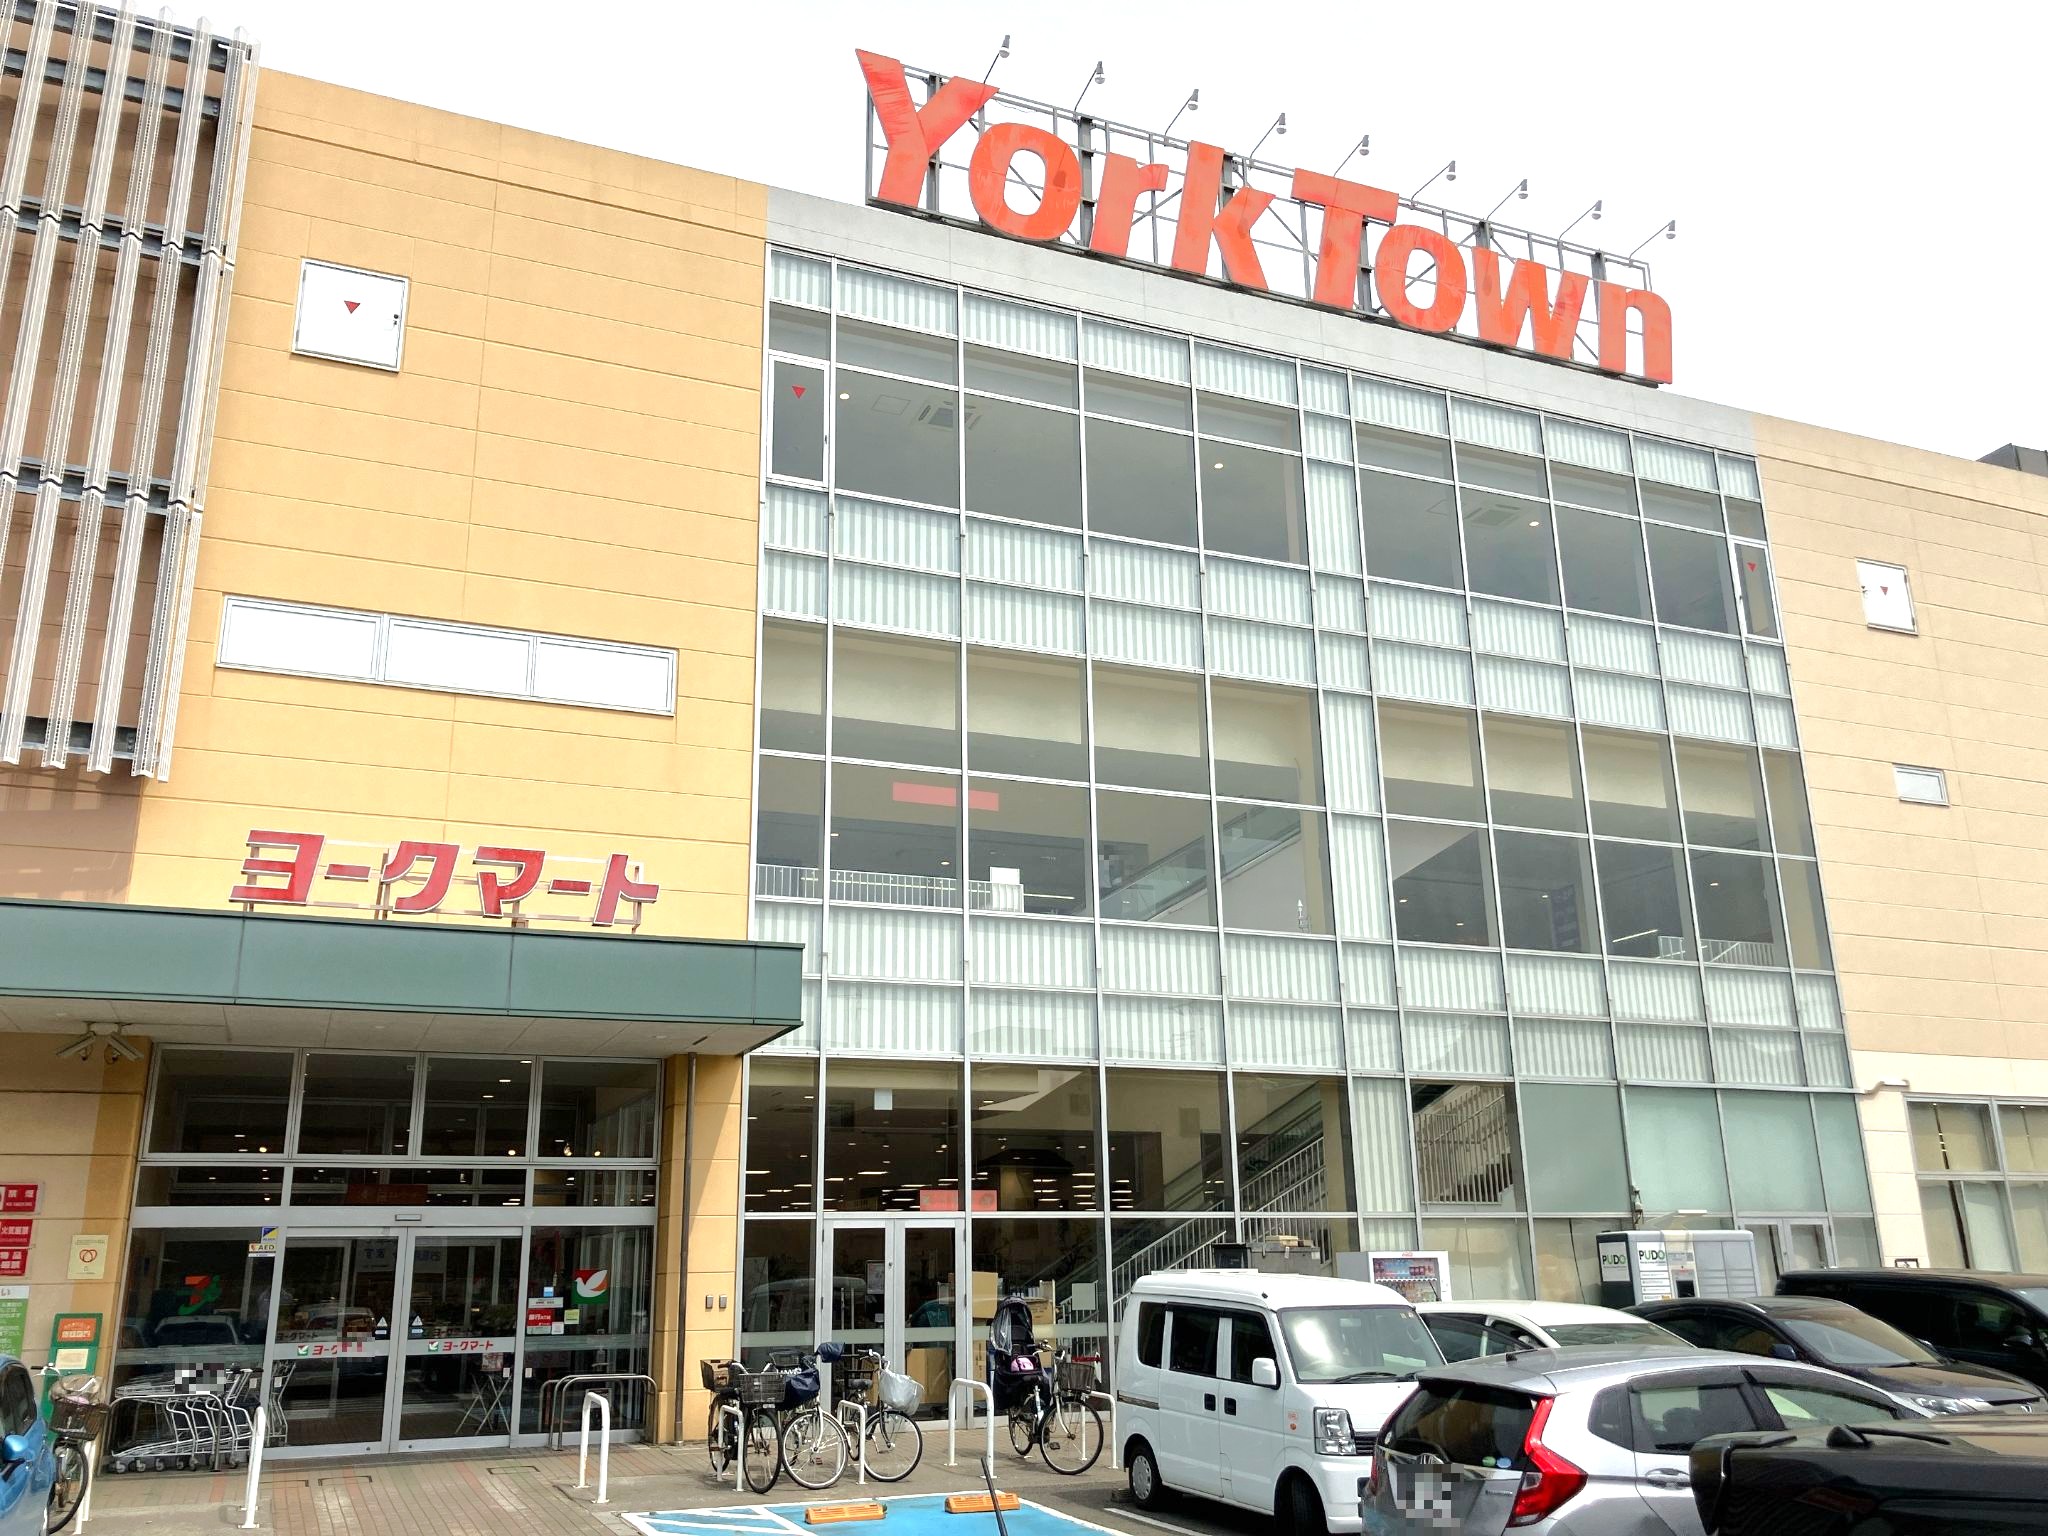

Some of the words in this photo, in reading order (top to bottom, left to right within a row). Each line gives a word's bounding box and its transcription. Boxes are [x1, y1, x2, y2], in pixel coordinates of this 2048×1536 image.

[229, 829, 660, 928] ヨークマート
[1602, 1254, 1626, 1265] PUDO
[1638, 1249, 1665, 1261] PUDO
[442, 1340, 494, 1353] ヨークマート
